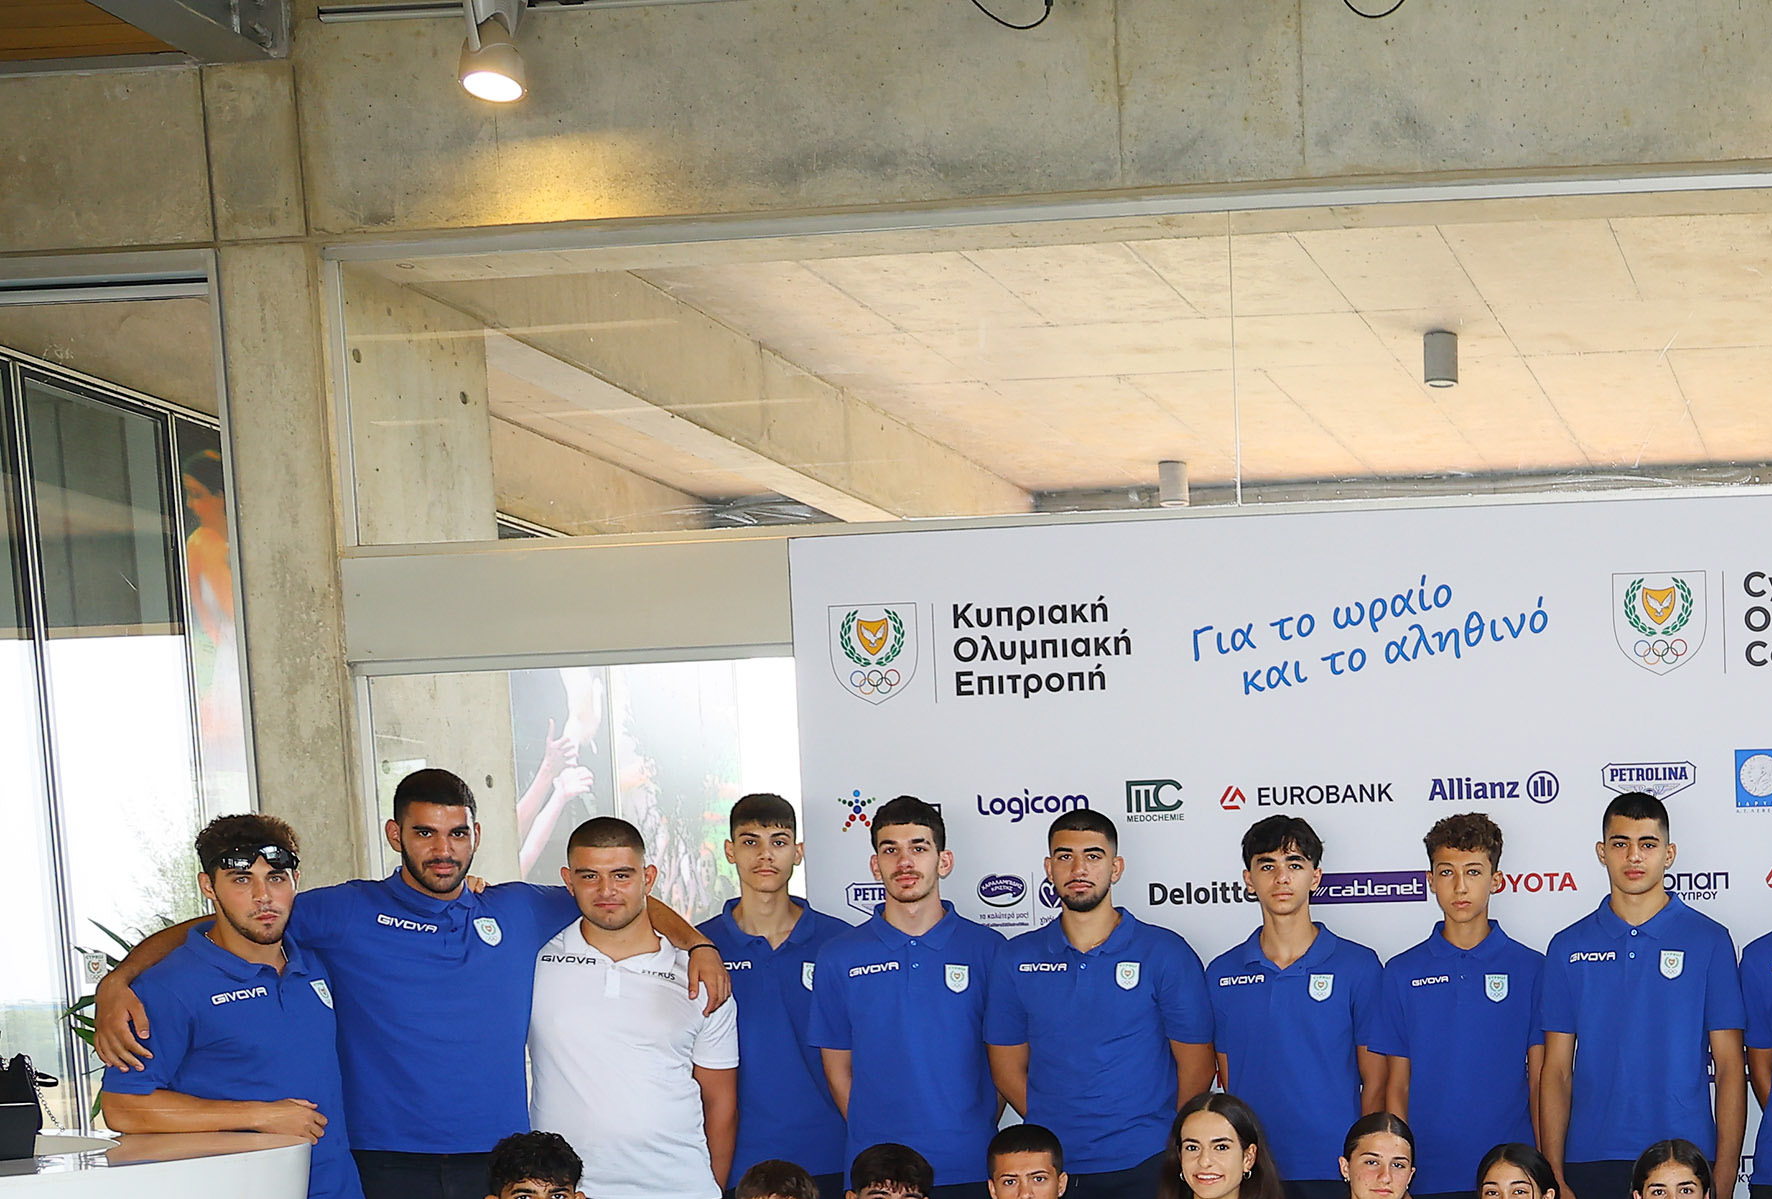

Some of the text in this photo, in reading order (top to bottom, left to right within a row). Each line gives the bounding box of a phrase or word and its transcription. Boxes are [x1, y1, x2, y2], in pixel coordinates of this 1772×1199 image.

[952, 596, 1109, 631] Κυπριακή
[1193, 573, 1453, 662] Για το ωραίο
[953, 629, 1132, 664] Ολυμπιακή
[1243, 595, 1549, 695] και το αληθινό
[955, 664, 1107, 699] Επιτροπή
[1610, 765, 1689, 782] PETROLINA
[1257, 783, 1393, 806] EUROBANK
[1429, 778, 1520, 800] Allianz
[1127, 813, 1185, 822] MEDOCHEMIE
[1328, 878, 1424, 899] cablenet
[1496, 872, 1577, 893] YOTA
[1678, 891, 1717, 901] ΥΠΡΟΥ
[377, 913, 438, 935] GIVOVA
[541, 954, 597, 967] GIVOVA
[1570, 951, 1616, 963] GIVOVA
[849, 961, 900, 978] GIVOVA
[1018, 962, 1068, 973] GIVOVA
[1219, 974, 1267, 986] GIVOVA
[1411, 975, 1450, 987] GIVOVA
[211, 986, 269, 1006] GIVOVA
